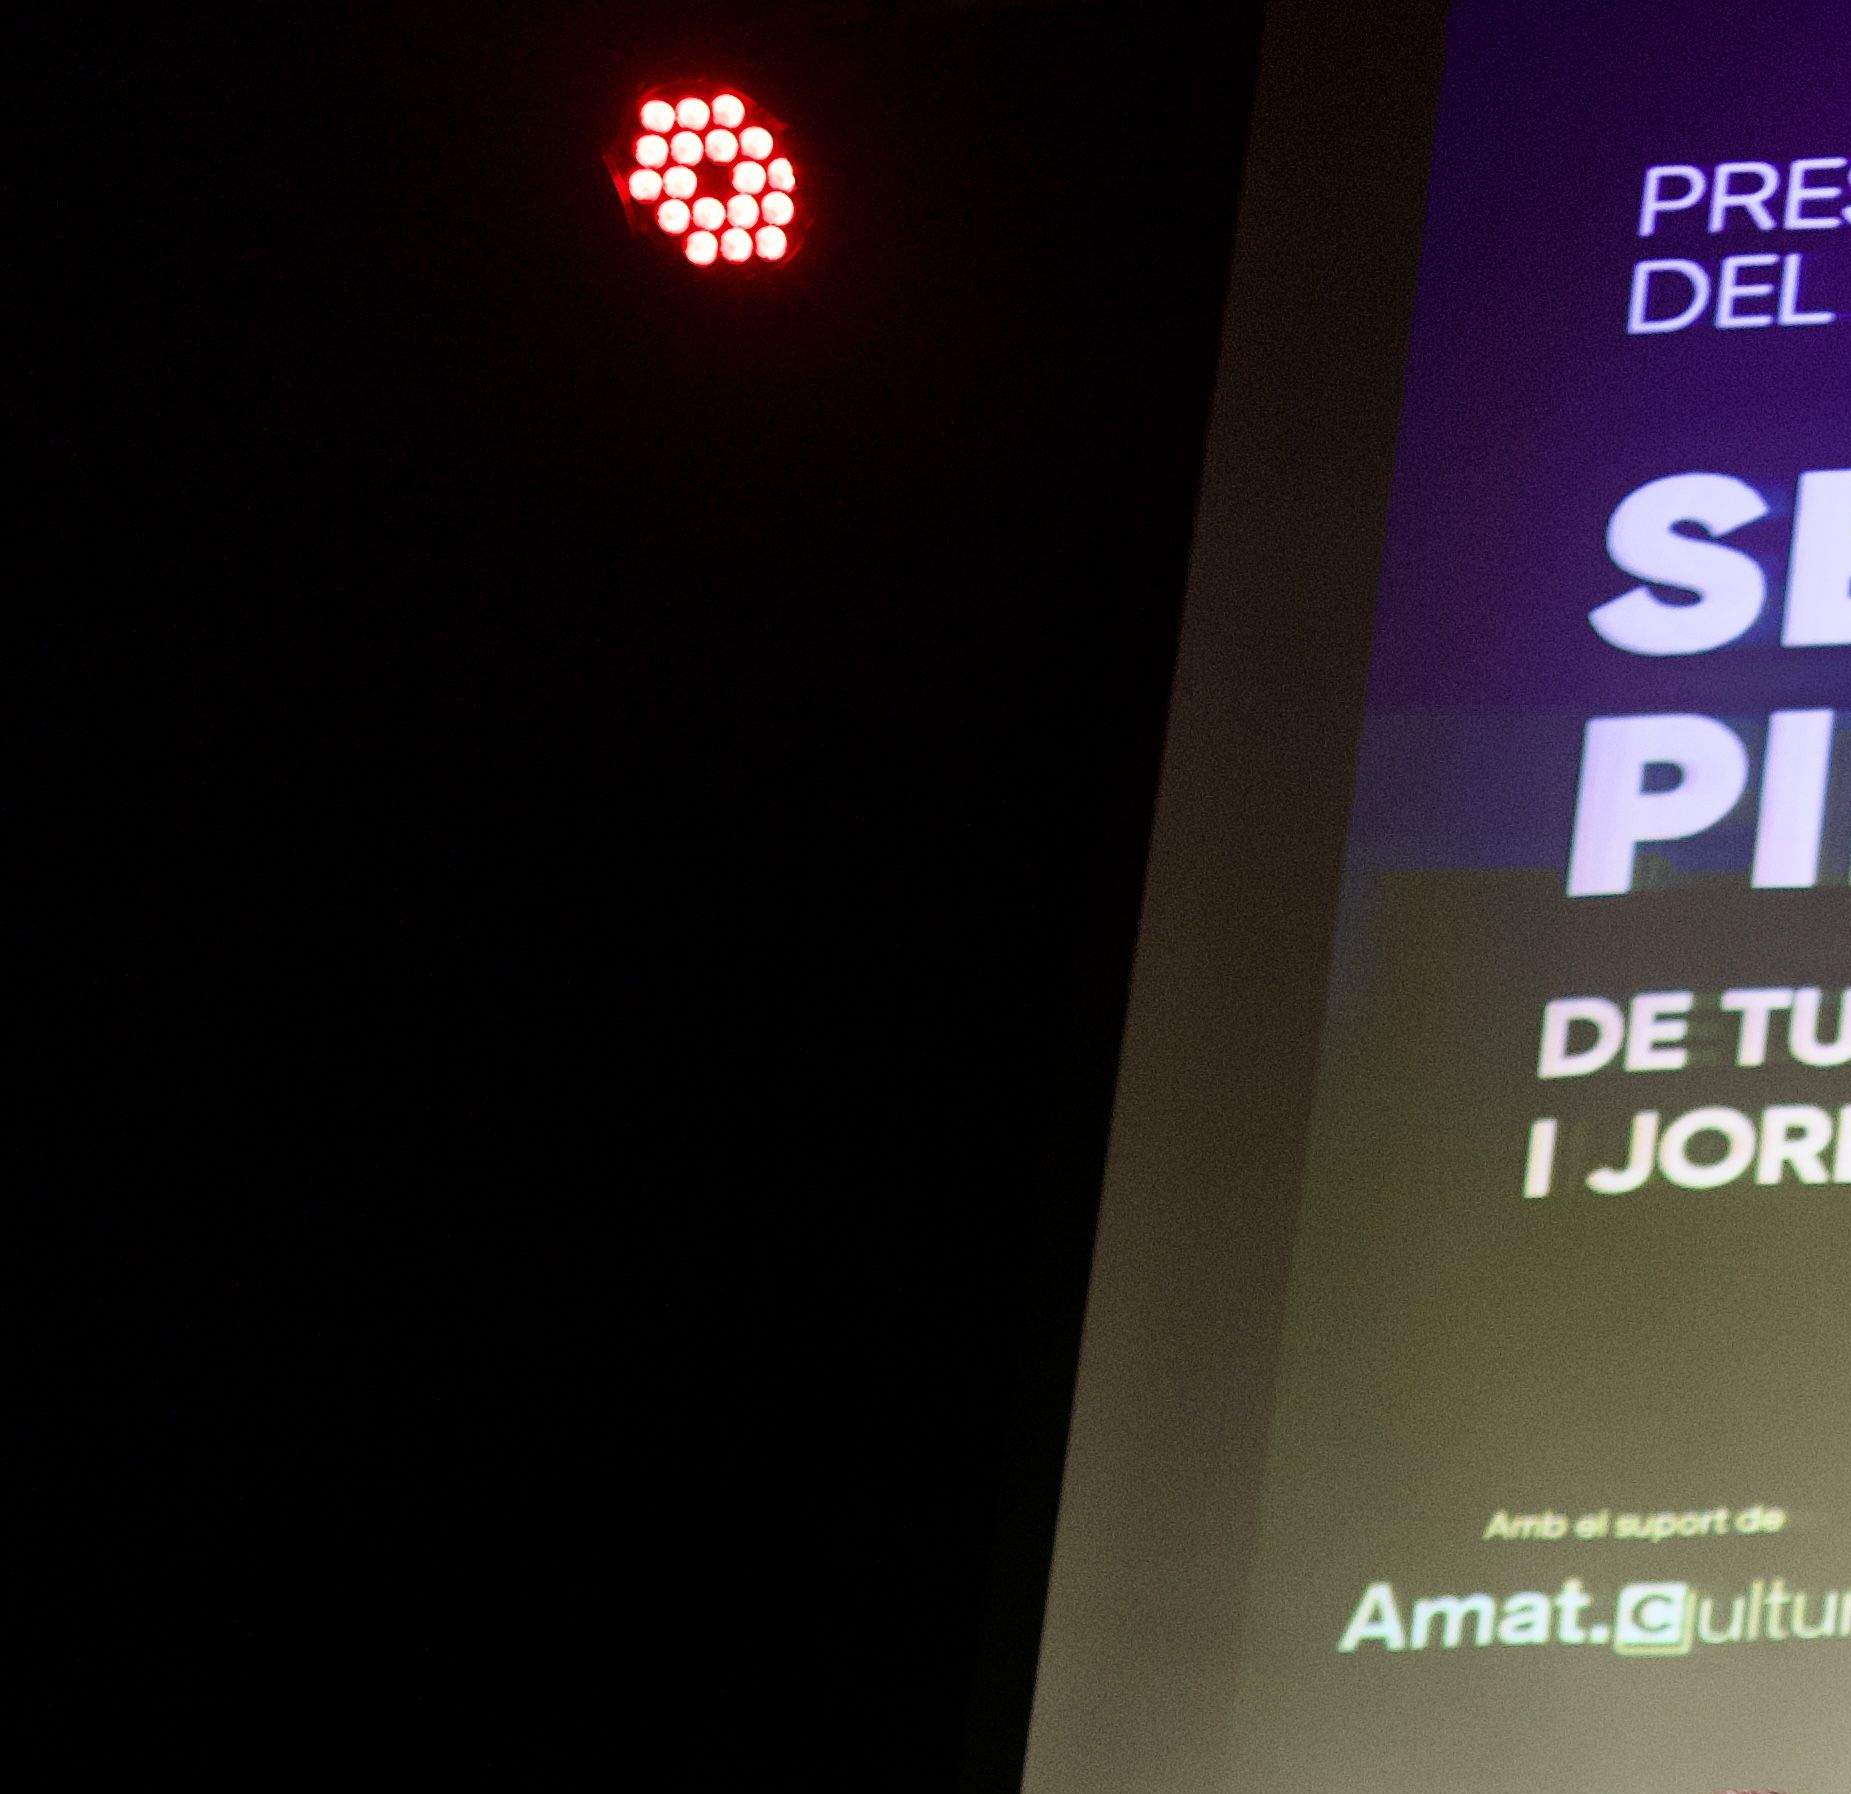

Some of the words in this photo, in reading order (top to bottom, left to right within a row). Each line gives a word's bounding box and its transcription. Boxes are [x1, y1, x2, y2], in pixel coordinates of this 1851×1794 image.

[1625, 252, 1834, 334] DEL
[1537, 992, 1693, 1079] DE
[1522, 1118, 1556, 1198] I
[1483, 1510, 1568, 1541] Amb
[1575, 1510, 1608, 1538] el
[1614, 1508, 1727, 1543] suport
[1739, 1504, 1788, 1534] de
